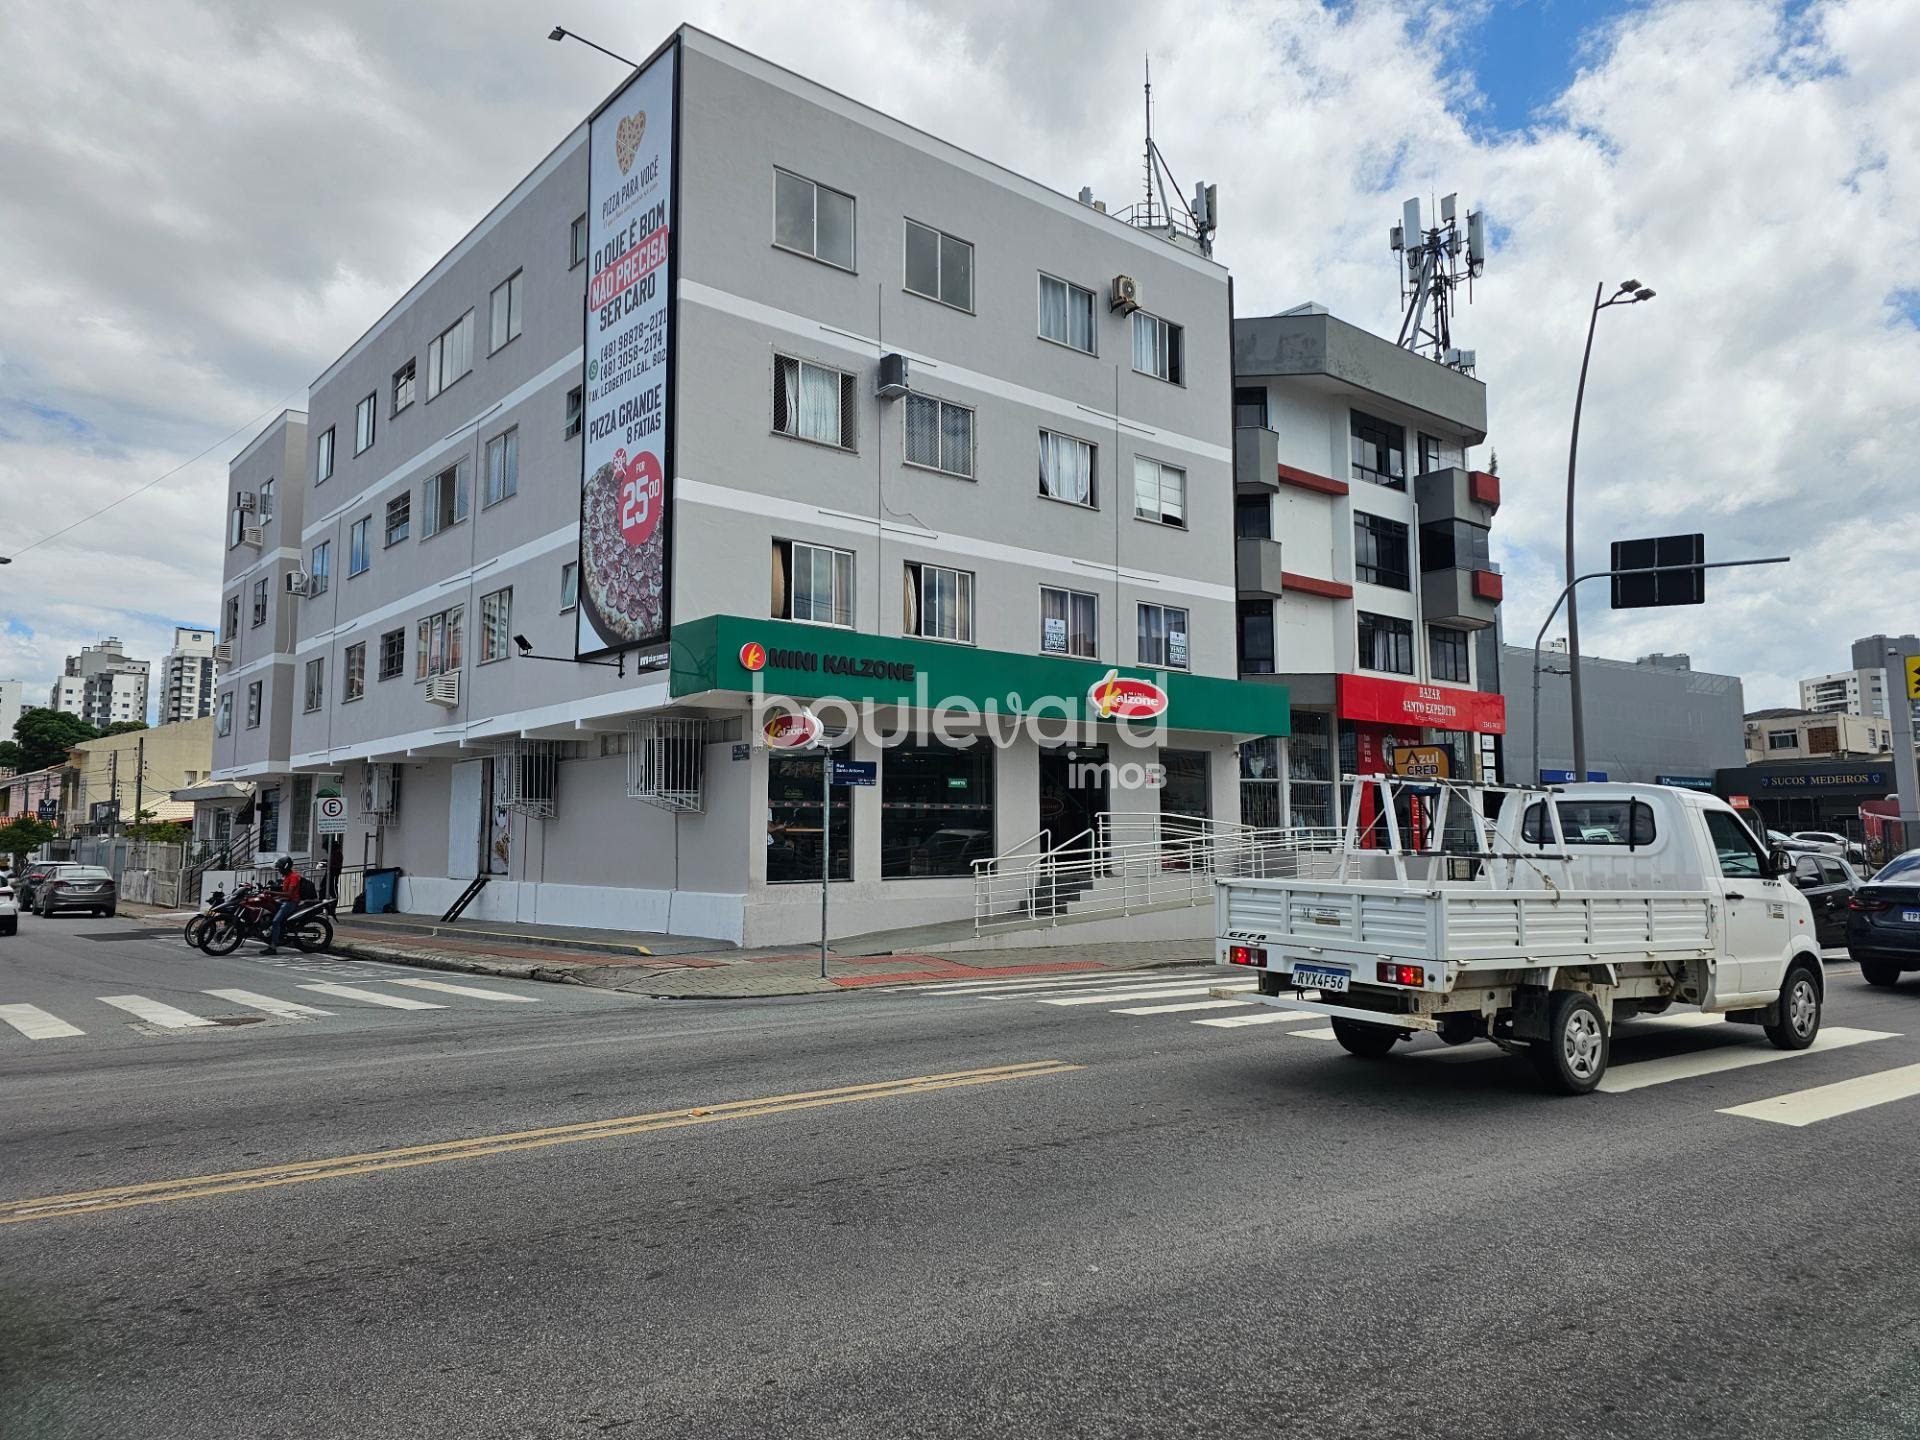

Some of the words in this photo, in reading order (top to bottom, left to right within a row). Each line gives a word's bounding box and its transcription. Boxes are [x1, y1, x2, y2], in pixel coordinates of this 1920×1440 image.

[602, 191, 620, 220] PIZZA
[621, 175, 639, 205] PARA
[640, 154, 659, 188] VOCÊ
[594, 249, 602, 275] O
[604, 229, 627, 267] QUE
[629, 217, 638, 249] É
[639, 198, 665, 242] BOM
[591, 271, 614, 309] NÃO
[615, 232, 667, 292] PRECISA
[600, 295, 622, 332] SER
[624, 271, 656, 315] CARO
[600, 339, 616, 363] (48)
[618, 307, 667, 352] 98878-2171
[600, 358, 616, 381] (48)
[617, 329, 663, 371] 3058-2174
[589, 408, 617, 444] PIZZA
[618, 383, 662, 428] GRANDE
[626, 426, 633, 445] 8
[633, 411, 662, 442] FATIAS
[768, 648, 818, 672] MINI
[823, 654, 915, 682] KALZONE
[1402, 700, 1425, 713] SANTO
[1425, 703, 1457, 717] EXPEDITO
[1419, 686, 1441, 700] BAZAR
[1407, 764, 1440, 776] CRED
[1771, 776, 1806, 786] SUCOS
[1810, 774, 1869, 785] MEDEIROS
[328, 802, 337, 813] E
[1228, 931, 1267, 940] EFFA
[1297, 971, 1344, 989] RYX4F56
